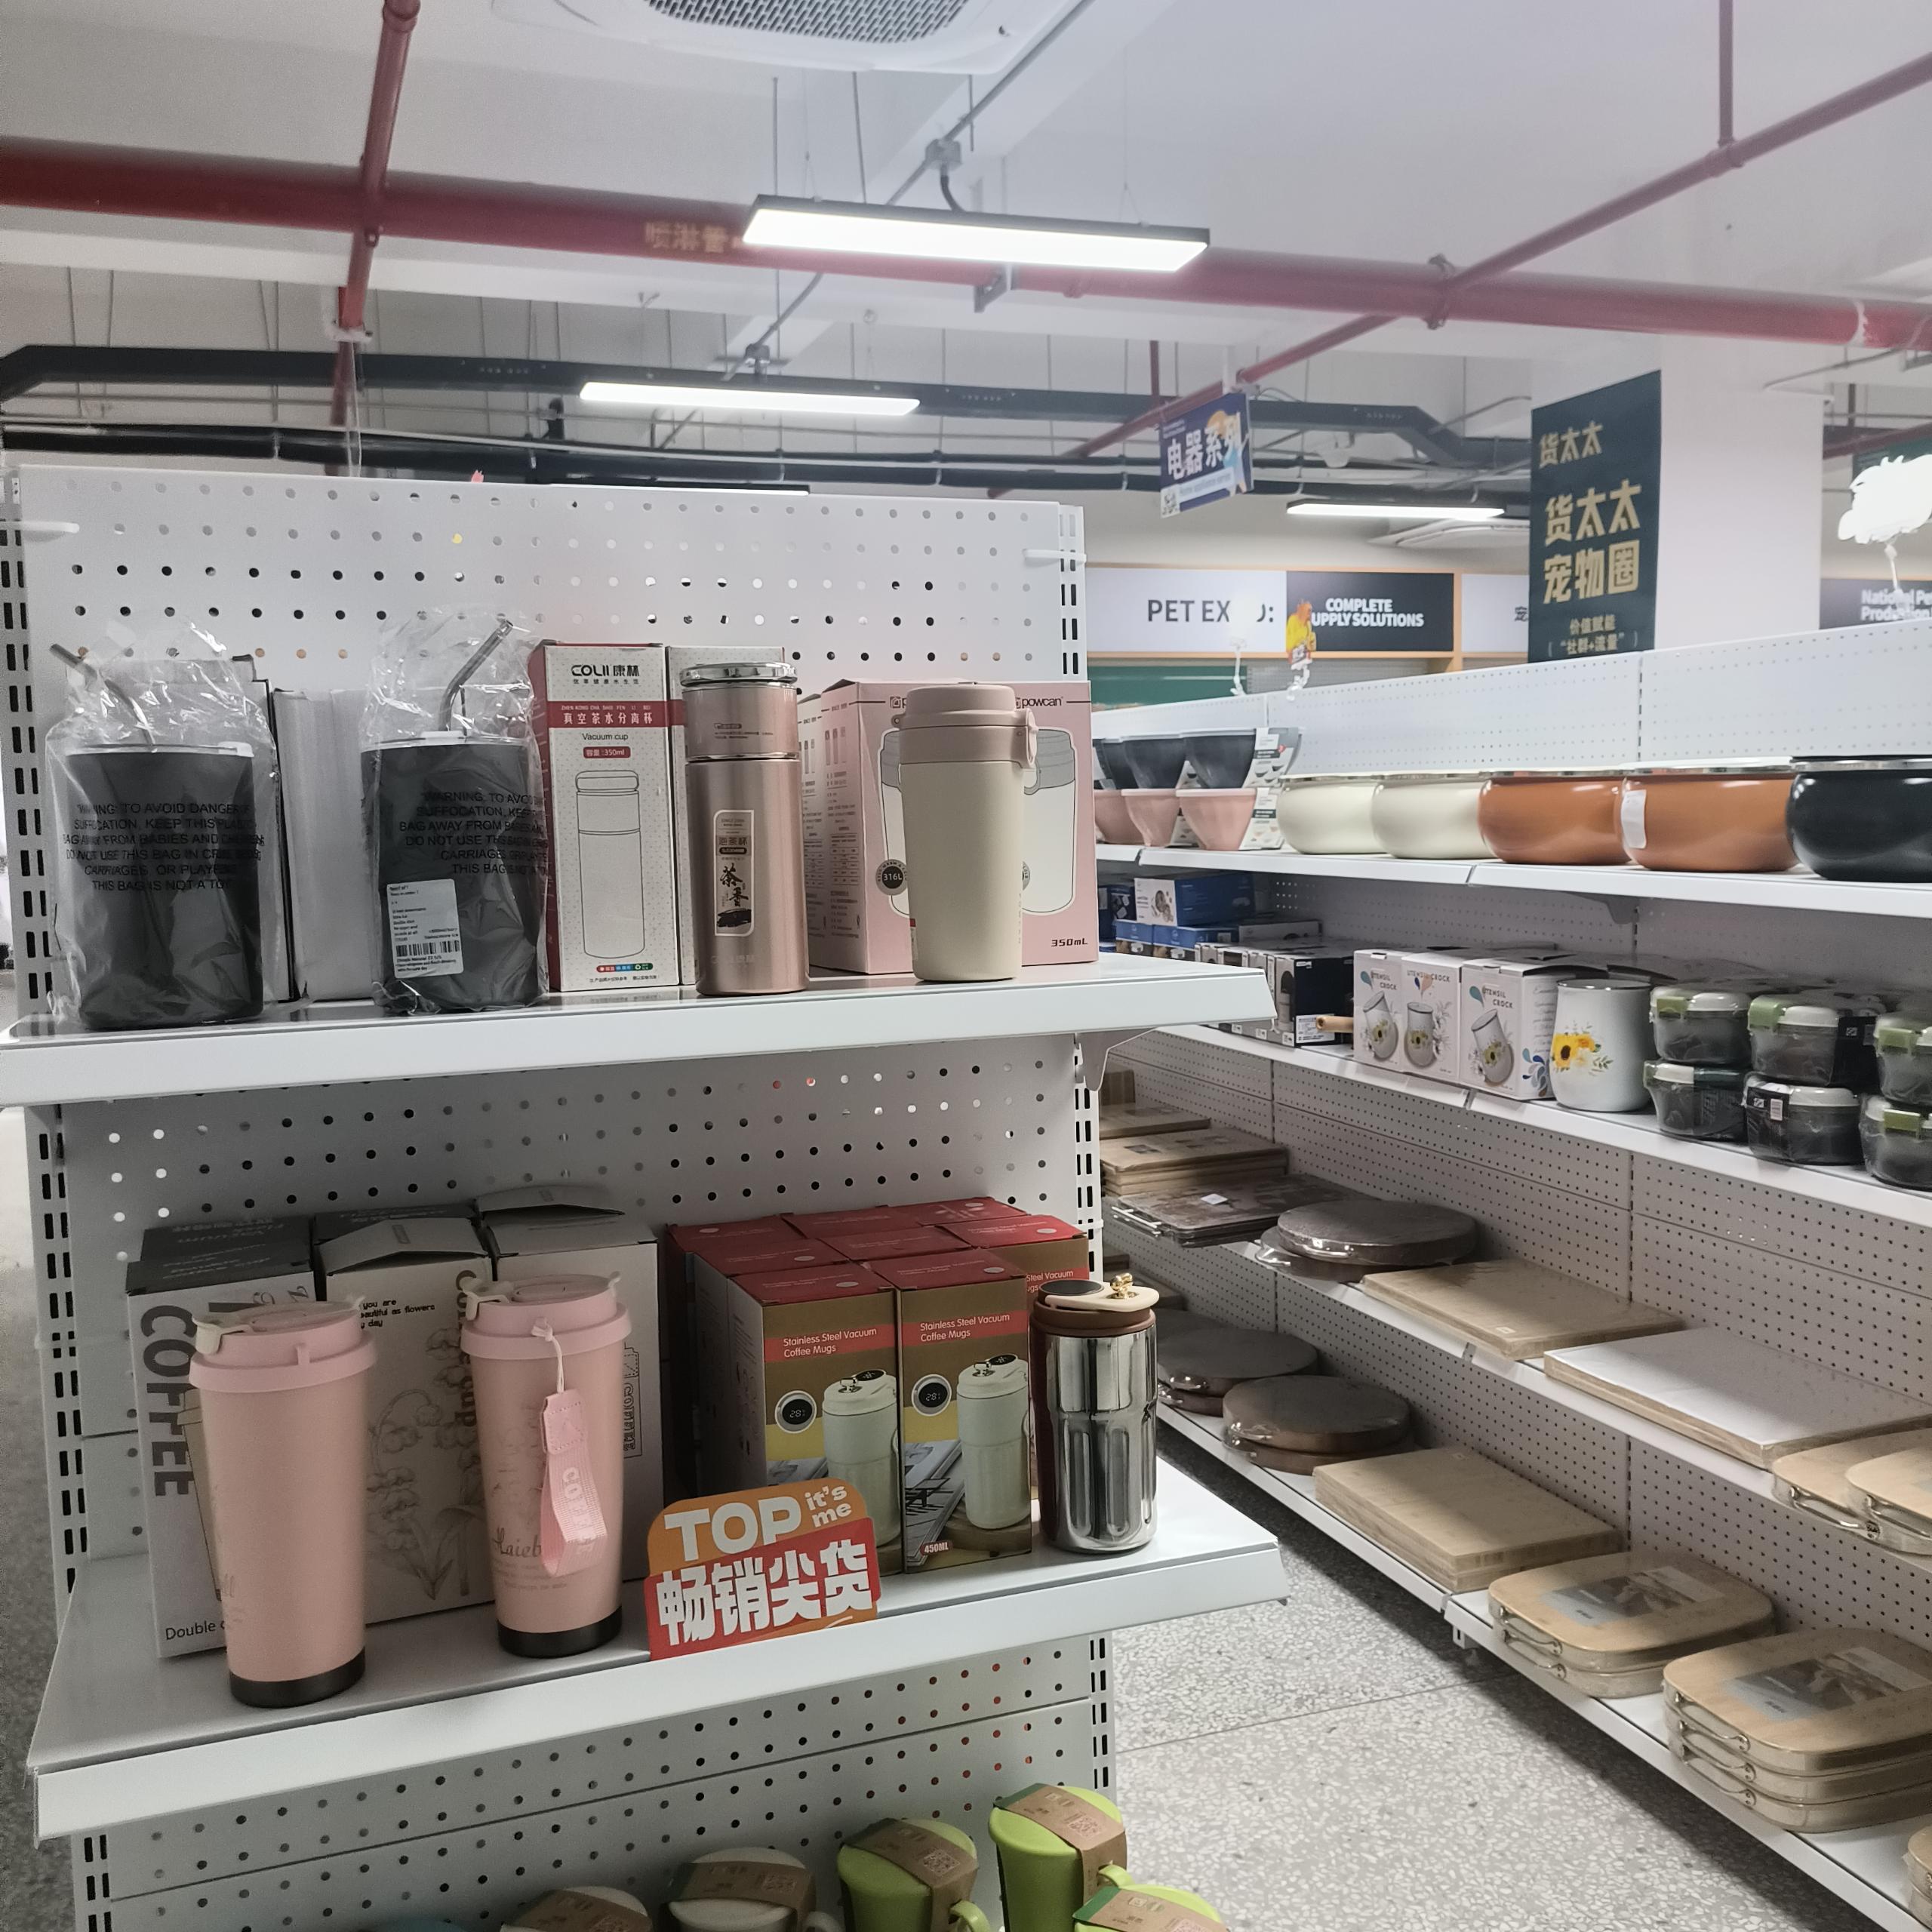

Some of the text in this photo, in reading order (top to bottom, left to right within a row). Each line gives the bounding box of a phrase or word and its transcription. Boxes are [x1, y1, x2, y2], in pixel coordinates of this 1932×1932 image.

[1168, 411, 1242, 480] 电器系列
[1539, 420, 1603, 469] 货太太
[1544, 478, 1642, 546] 货太太
[1543, 539, 1640, 605] 宠物圈
[1148, 600, 1275, 623] PET EX:
[1326, 598, 1393, 613] COMPLETE
[1312, 612, 1425, 628] UPPLY SOLUTIONS
[613, 665, 640, 676] 康林
[1022, 698, 1062, 709] powcan
[563, 712, 653, 725] 真空茶水分离杯
[491, 792, 504, 803] TO
[144, 803, 186, 814] AVOID
[145, 818, 182, 829] KEEP
[187, 818, 215, 829] THIS
[399, 820, 426, 831] BAG
[428, 820, 463, 831] AWAY
[466, 820, 502, 831] FROM
[104, 834, 136, 844] FROM
[192, 833, 219, 844] AND
[405, 836, 424, 846] DO
[427, 835, 454, 846] NOT
[456, 835, 483, 845] USE
[121, 849, 149, 860] THIS
[152, 848, 181, 860] BAG
[185, 849, 199, 859] IN
[157, 864, 177, 875] OR
[452, 863, 480, 874] THIS
[483, 863, 506, 874] BAG
[92, 880, 114, 891] THIS
[117, 880, 146, 891] BAG
[198, 879, 205, 890] A
[1051, 937, 1088, 948] 350mL
[1430, 973, 1451, 983] CROCK
[1493, 998, 1513, 1009] CROCK
[1026, 1270, 1074, 1282] Steel Vacuum
[363, 1302, 377, 1310] you
[405, 1304, 435, 1314] flowers
[920, 1314, 1010, 1331] Stainless Steel Vacuum
[783, 1327, 877, 1347] Stainless Steel Vacuum
[921, 1329, 971, 1343] Coffee Mugs
[783, 1344, 836, 1358] Coffee Mugs
[812, 1502, 852, 1527] me
[663, 1496, 801, 1562] TOP
[924, 1542, 949, 1555] 450ML
[656, 1538, 873, 1646] 畅销尖货
[165, 1620, 216, 1640] Double
